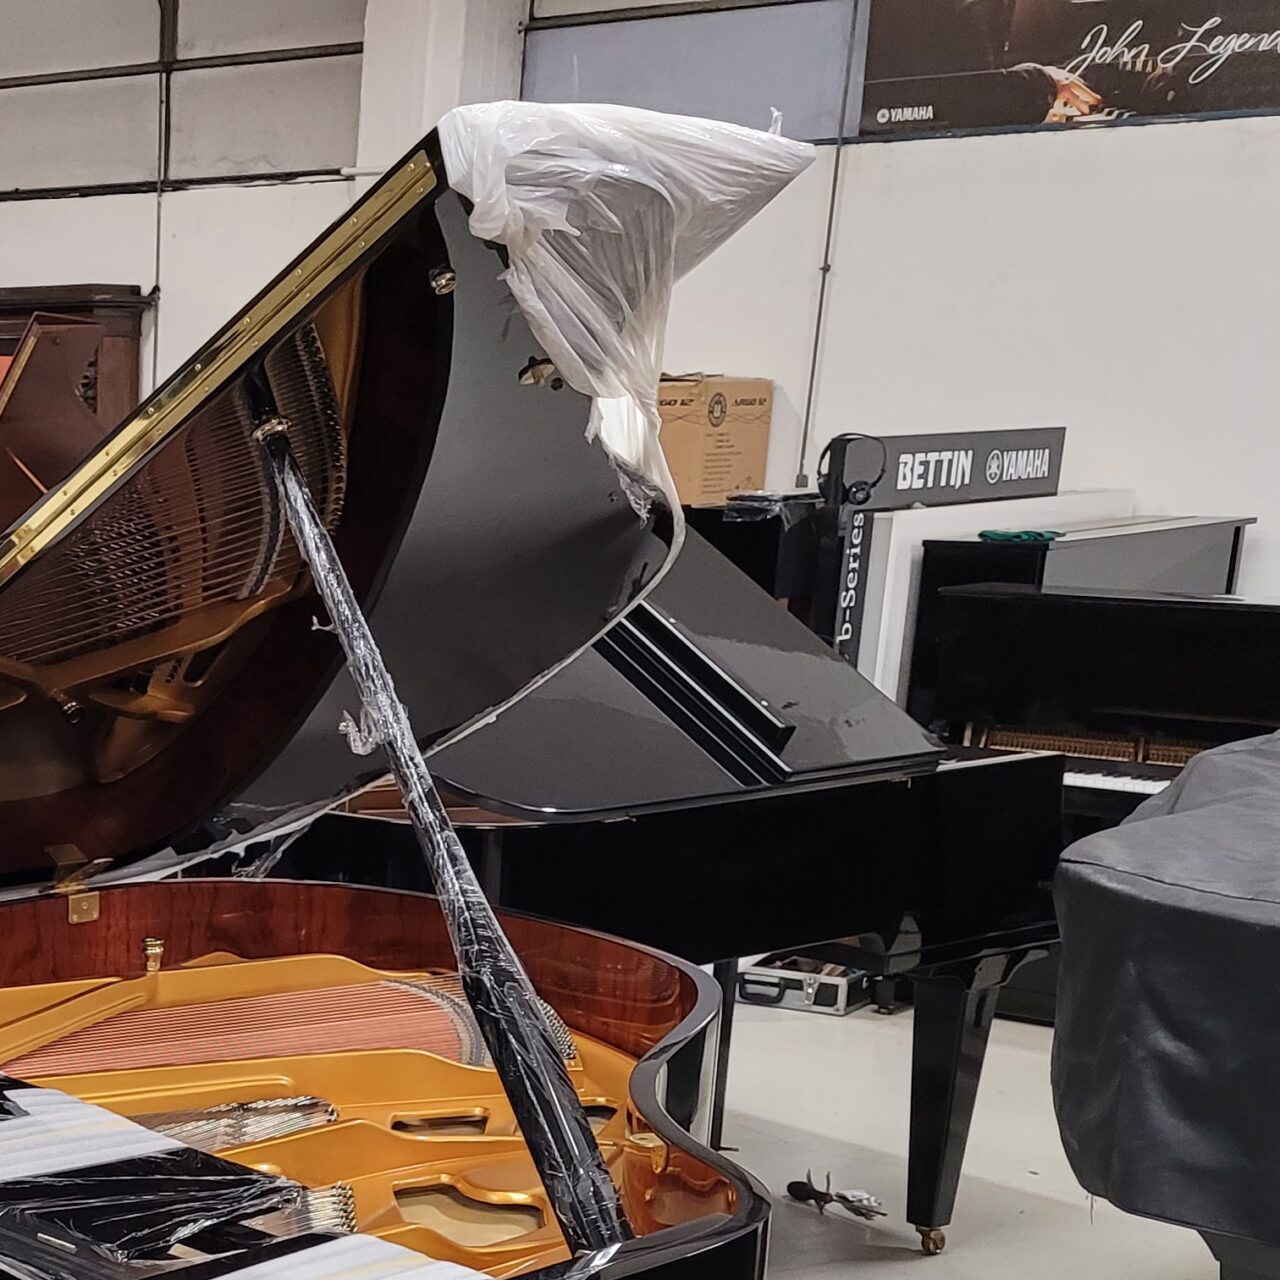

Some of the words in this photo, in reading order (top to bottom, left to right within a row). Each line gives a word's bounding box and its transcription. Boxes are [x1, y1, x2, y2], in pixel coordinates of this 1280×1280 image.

[1064, 19, 1150, 78] John
[890, 104, 933, 122] YAMAHA
[897, 450, 973, 490] BETTIN
[1002, 448, 1050, 481] YAMAHA
[836, 512, 864, 643] b-Series
